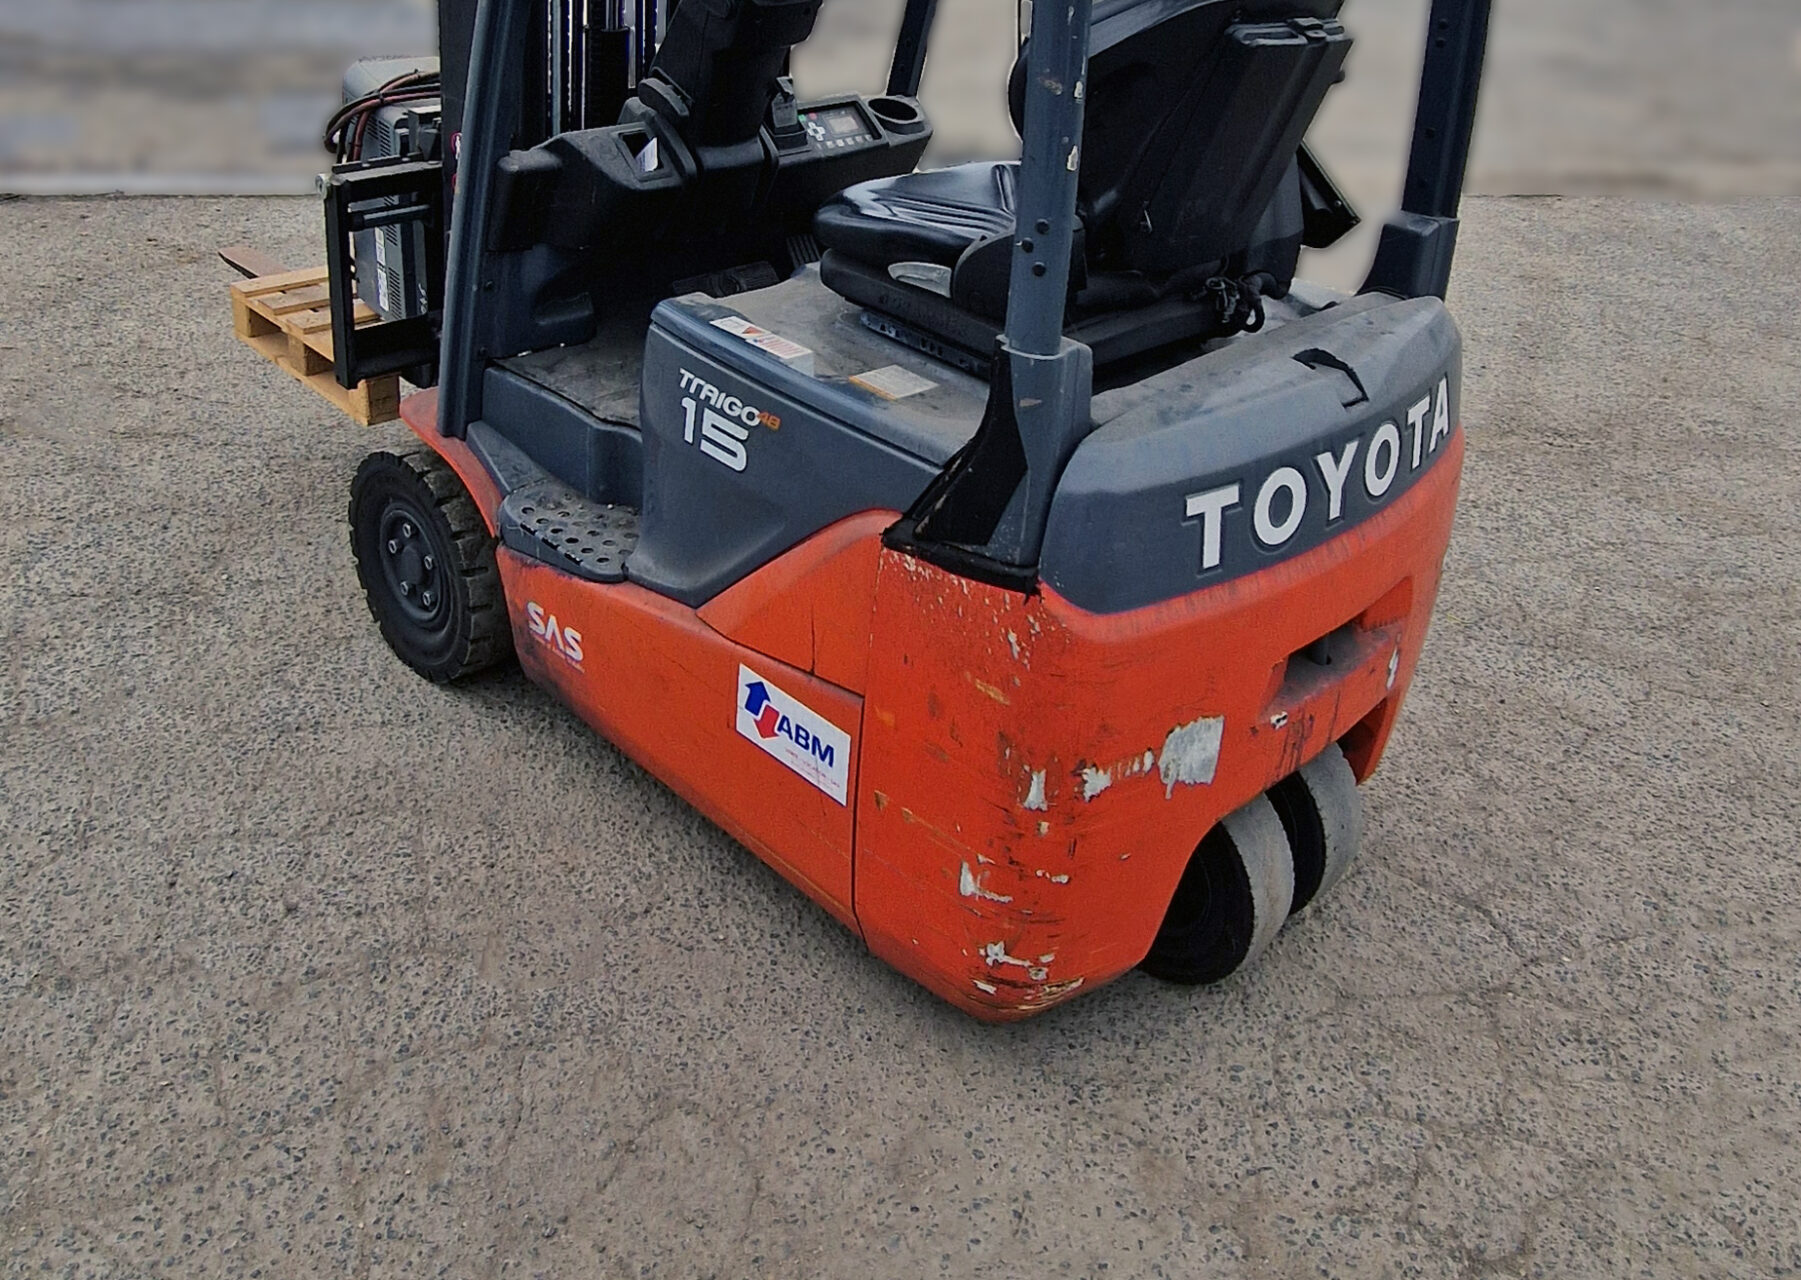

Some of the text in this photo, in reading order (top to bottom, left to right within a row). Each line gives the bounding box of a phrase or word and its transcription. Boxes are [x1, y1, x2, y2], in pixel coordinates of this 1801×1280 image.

[681, 396, 749, 471] 15
[1186, 376, 1449, 569] TOYOTA
[527, 601, 584, 661] SAS
[777, 715, 834, 768] ABM
